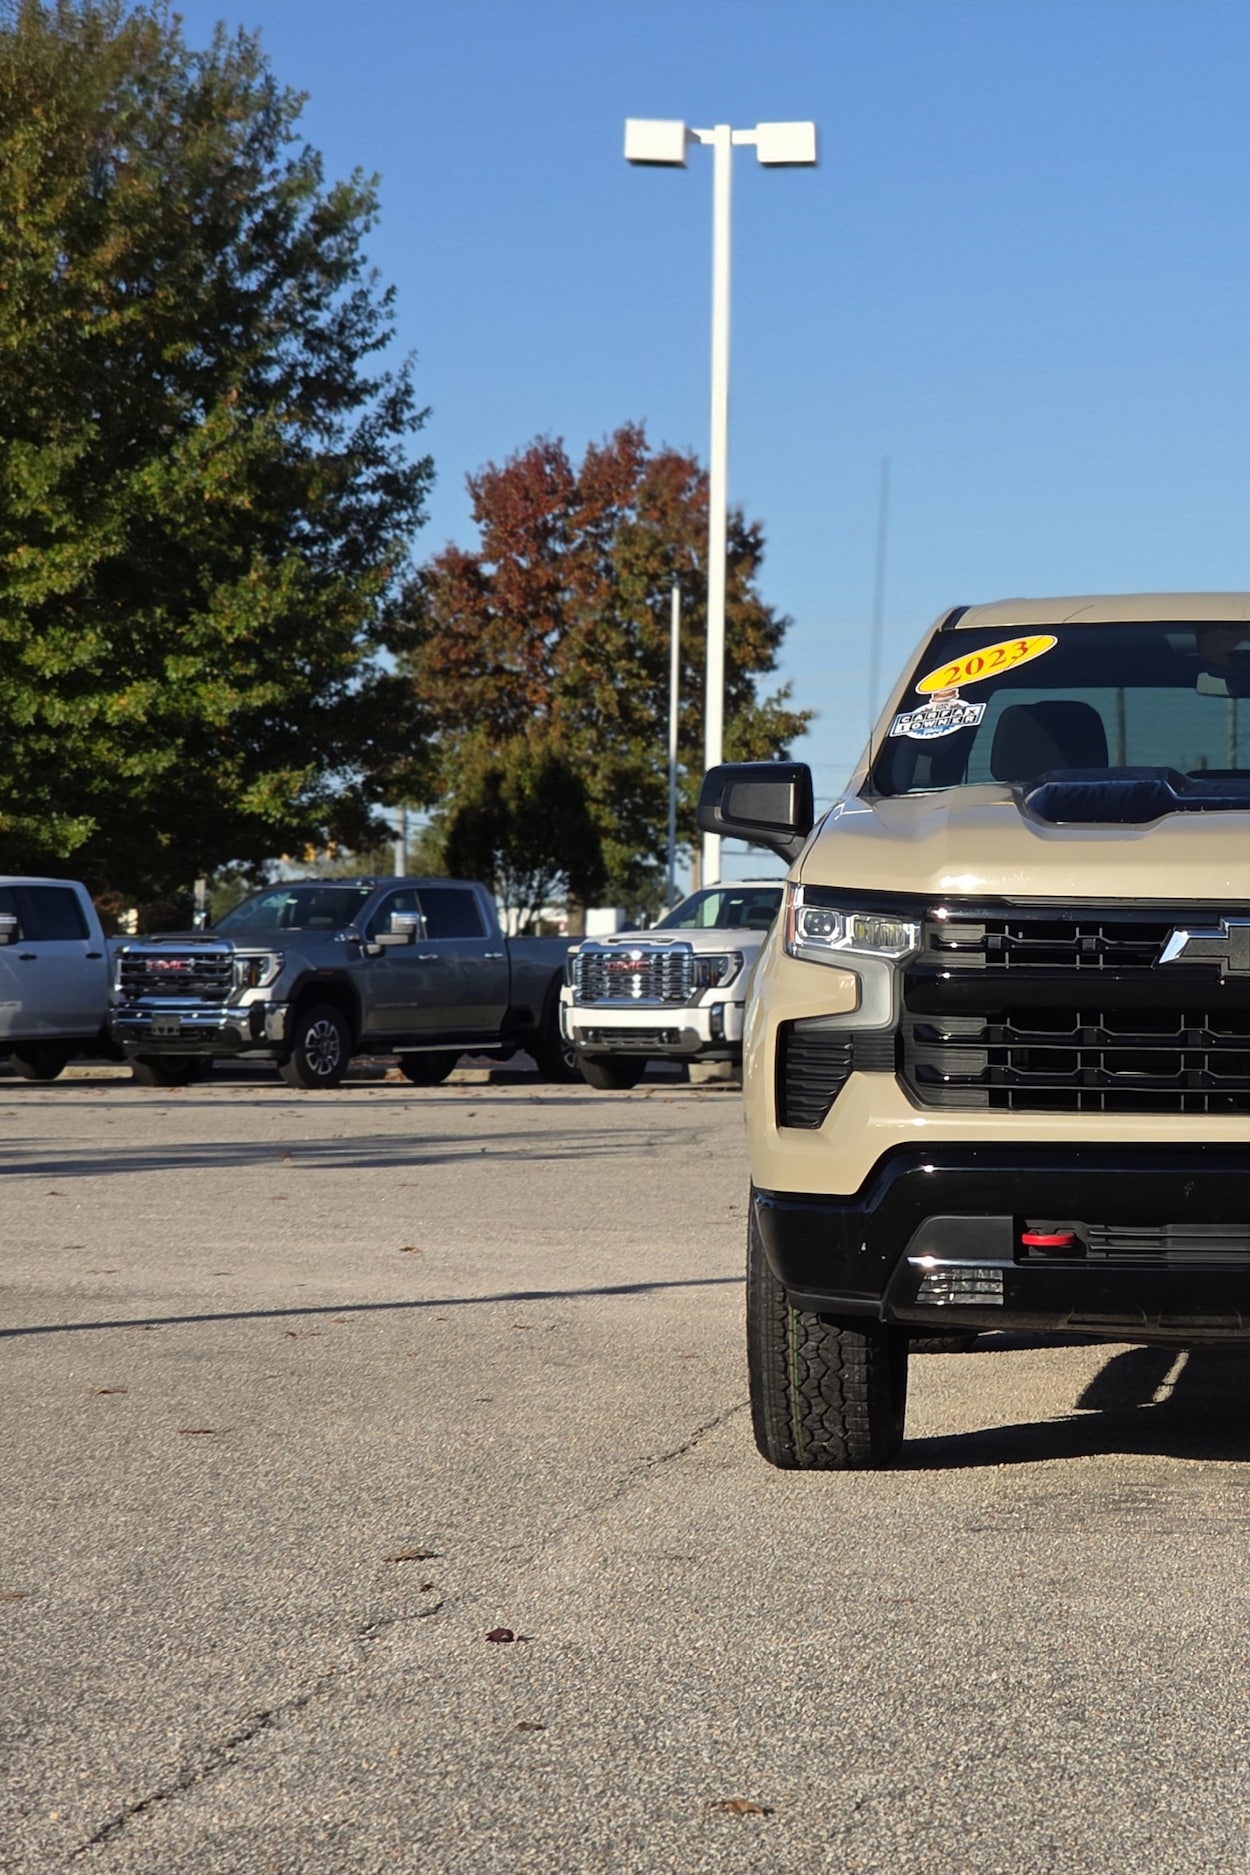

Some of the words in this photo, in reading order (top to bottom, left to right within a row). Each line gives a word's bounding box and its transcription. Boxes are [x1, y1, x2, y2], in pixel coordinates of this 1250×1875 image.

[943, 640, 1029, 687] 2023
[900, 708, 977, 724] CARFAX
[911, 715, 975, 730] OWNER
[148, 960, 191, 971] GMC
[605, 961, 649, 972] GMC
